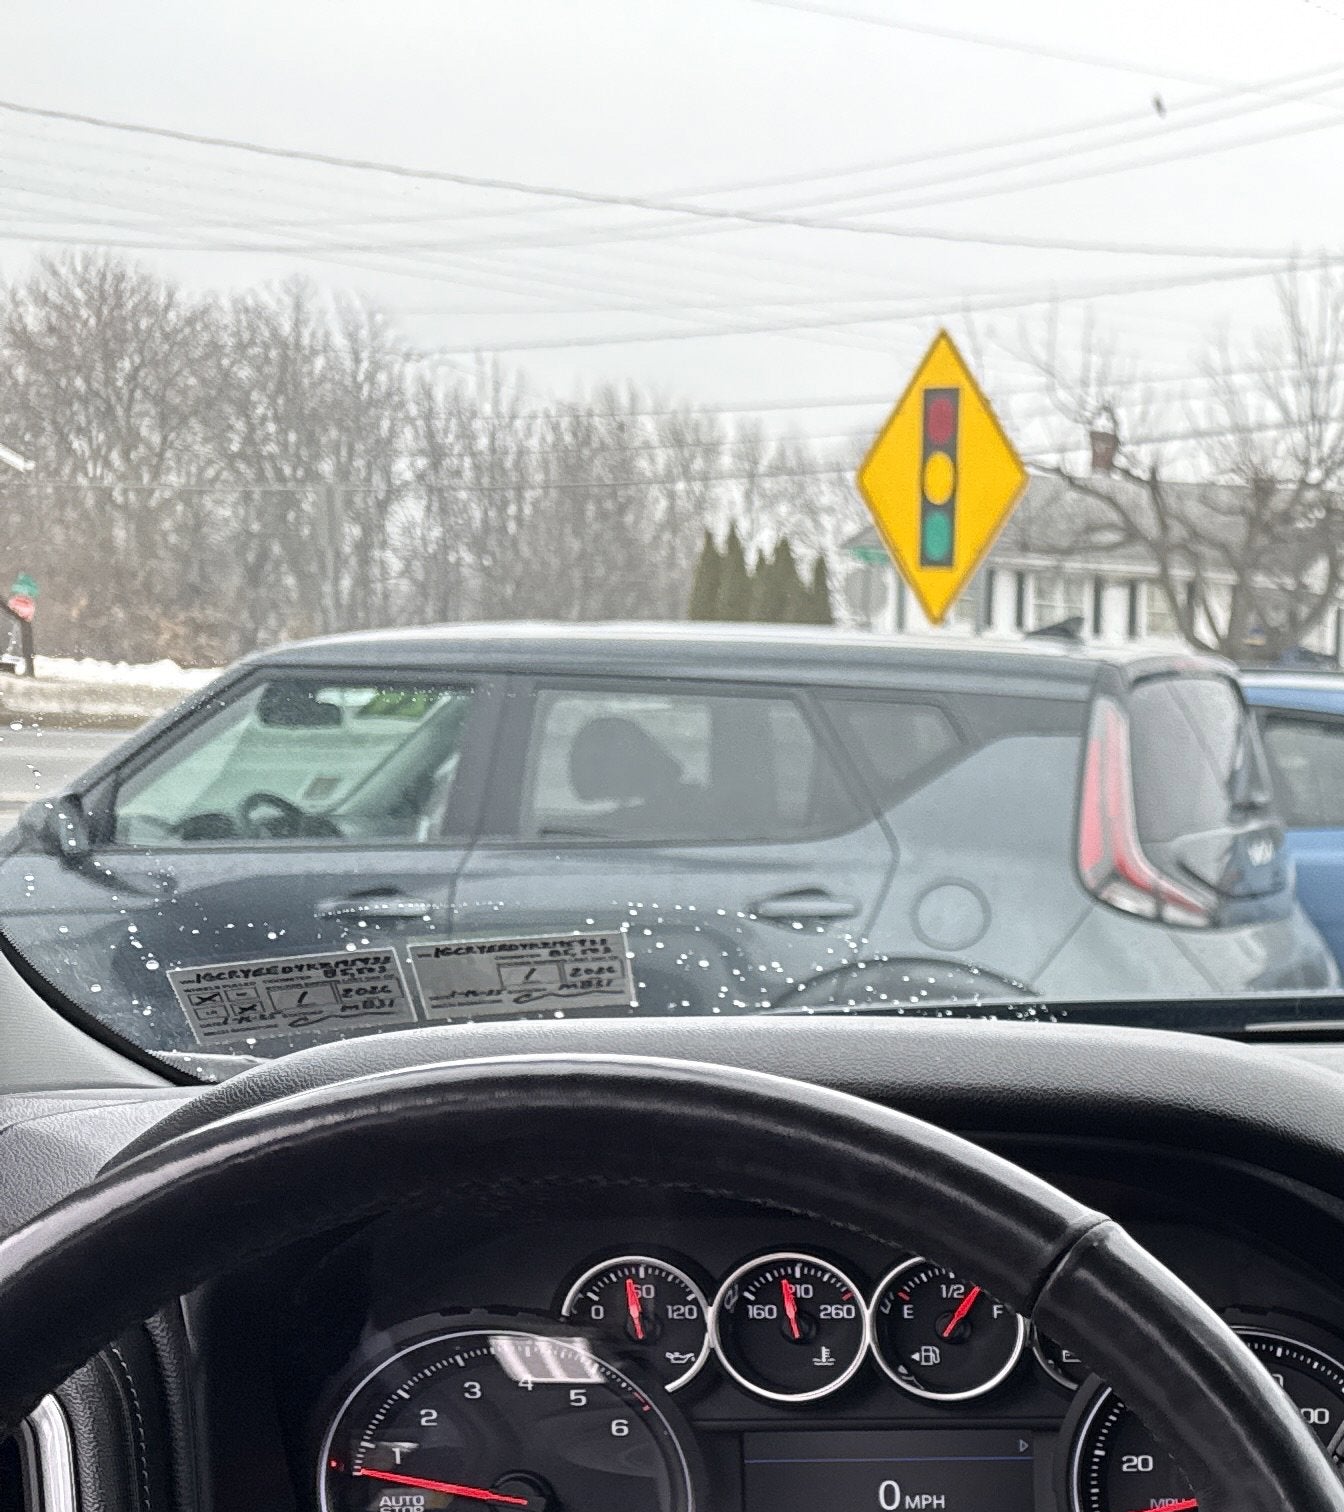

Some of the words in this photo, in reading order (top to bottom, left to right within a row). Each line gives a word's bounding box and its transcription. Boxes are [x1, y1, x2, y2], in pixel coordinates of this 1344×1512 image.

[940, 1284, 965, 1299] 1/2
[591, 1305, 604, 1320] 0
[667, 1305, 698, 1320] 120
[748, 1305, 777, 1319] 160
[820, 1304, 856, 1319] 260
[903, 1305, 914, 1319] E
[993, 1304, 1004, 1319] F
[463, 1381, 482, 1399] 3
[518, 1375, 533, 1391] 4
[569, 1389, 588, 1407] 5
[420, 1408, 438, 1427] 2
[611, 1419, 629, 1437] 6
[391, 1447, 401, 1465] 1
[1121, 1454, 1154, 1472] 20
[379, 1495, 424, 1507] AUTO
[878, 1480, 901, 1511] 0
[905, 1495, 946, 1510] MPH
